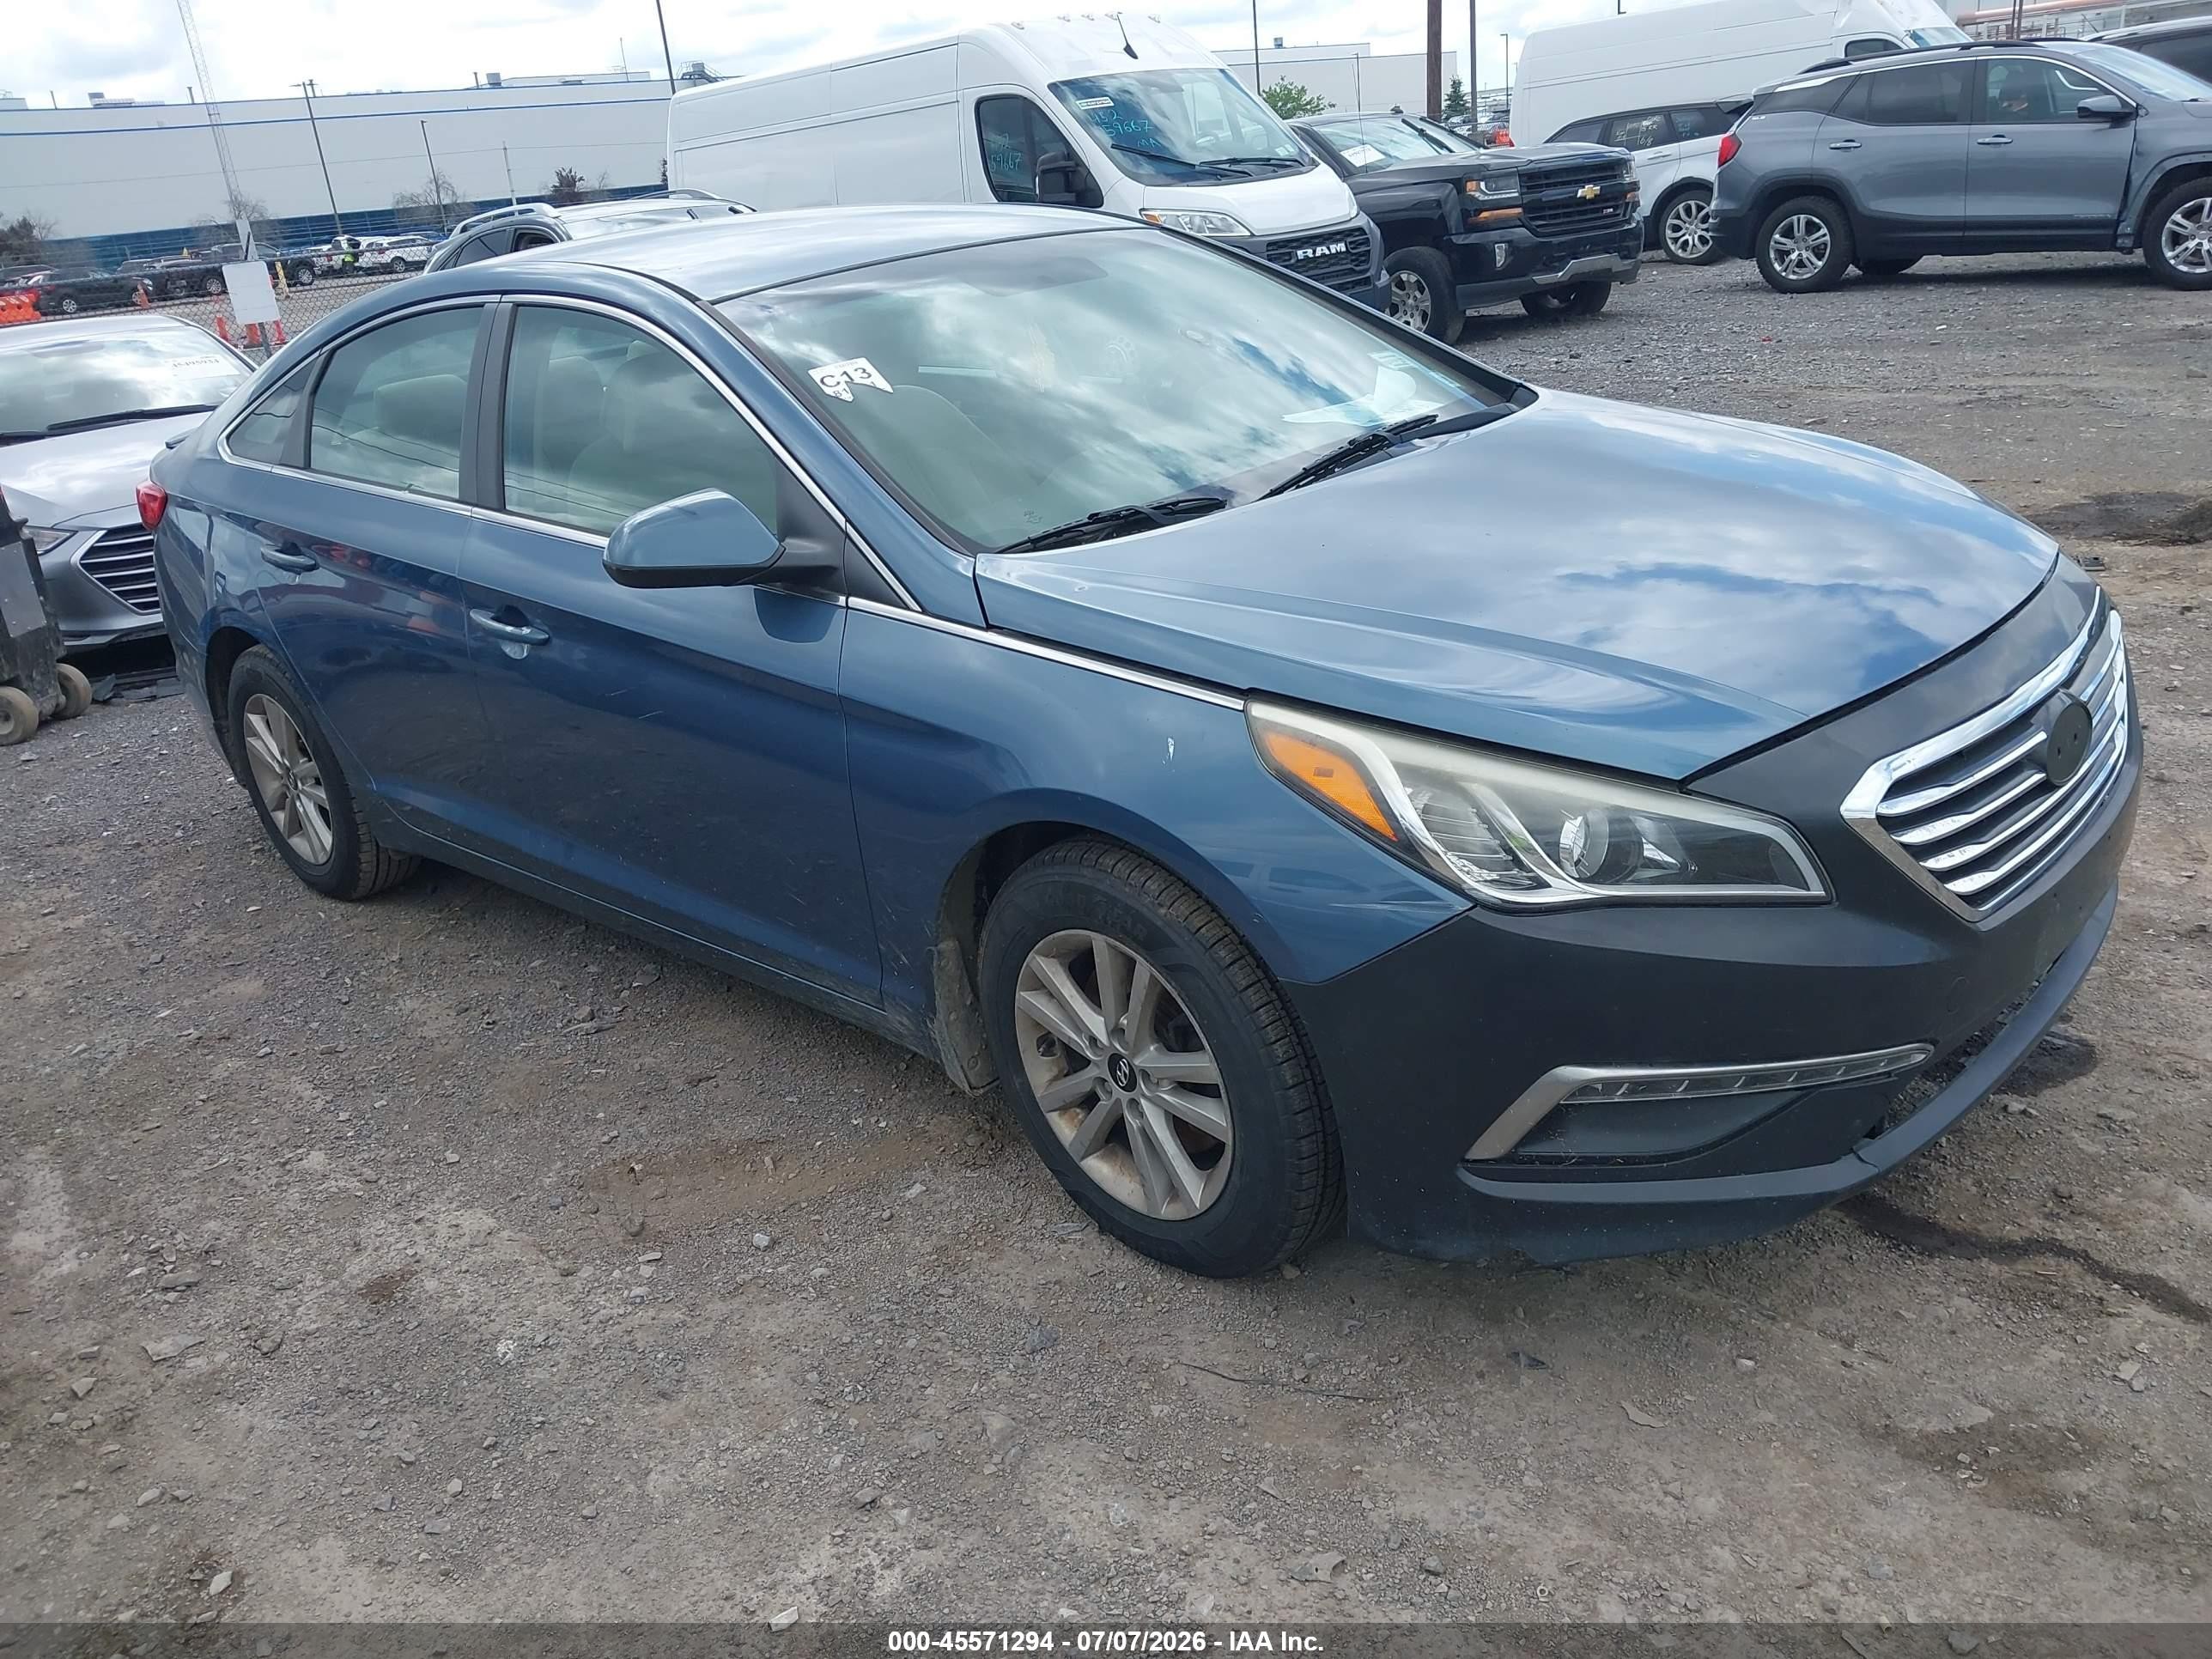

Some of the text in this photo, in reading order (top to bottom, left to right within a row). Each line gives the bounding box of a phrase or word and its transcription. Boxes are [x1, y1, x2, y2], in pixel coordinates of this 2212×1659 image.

[1088, 109, 1123, 124] 452
[1101, 120, 1154, 137] 59667
[1297, 242, 1346, 259] RAM
[819, 367, 872, 388] C13
